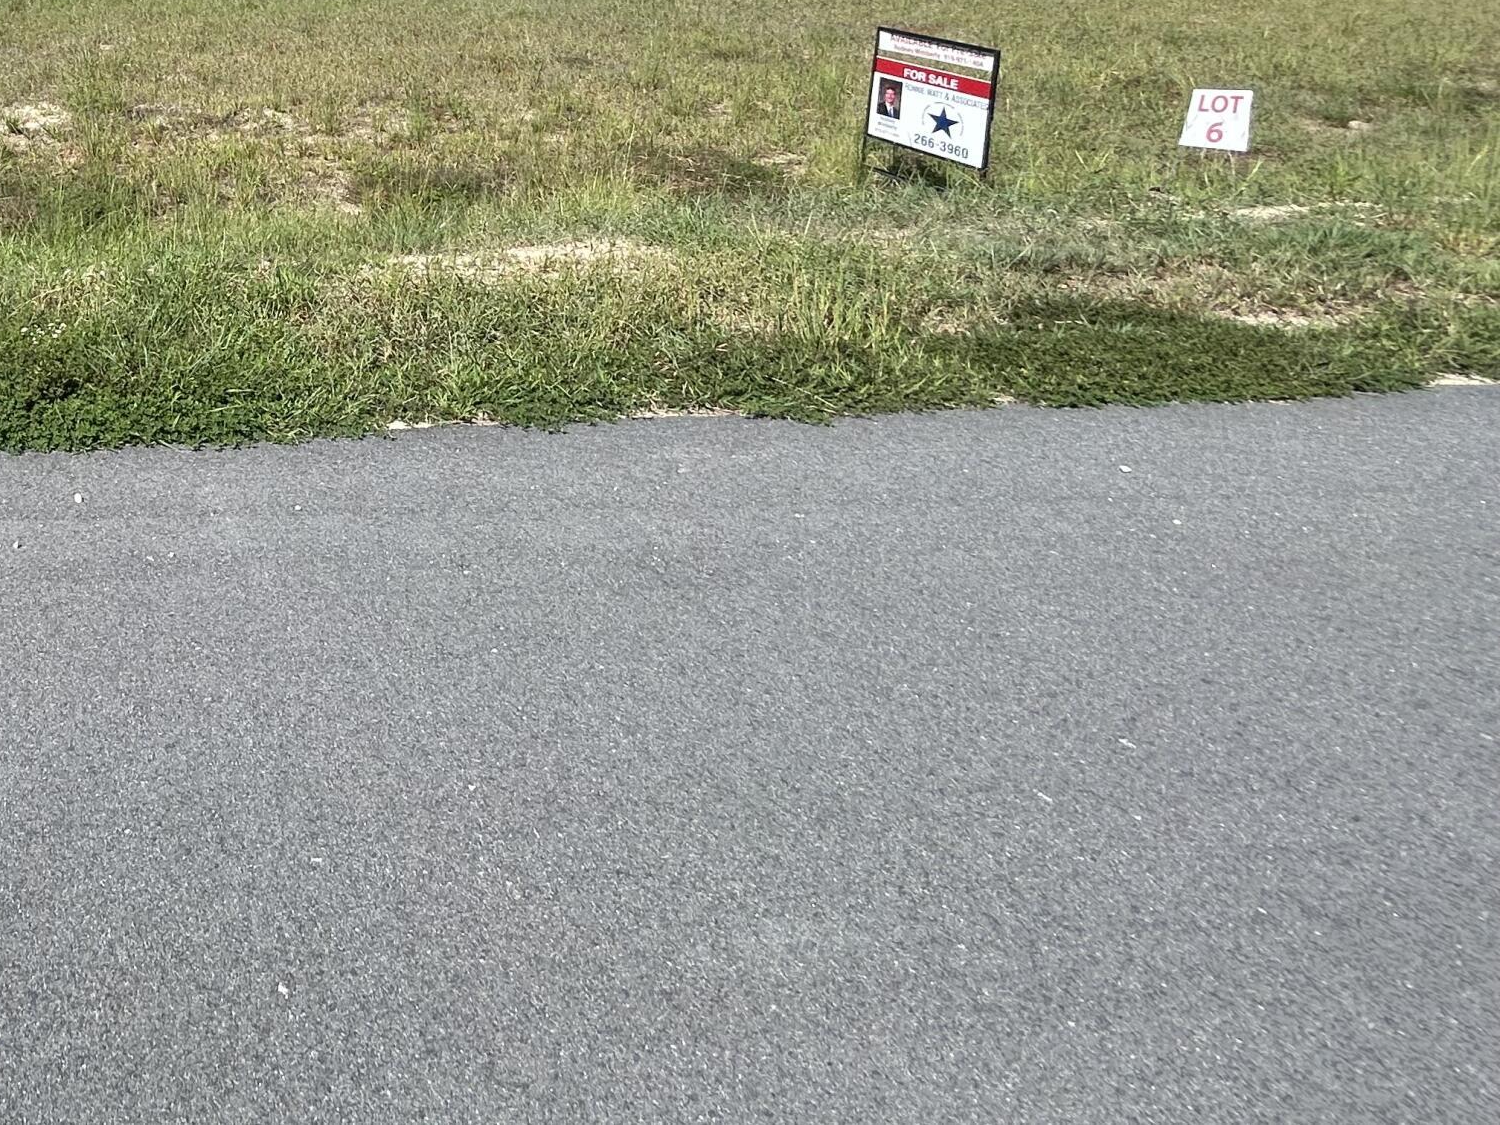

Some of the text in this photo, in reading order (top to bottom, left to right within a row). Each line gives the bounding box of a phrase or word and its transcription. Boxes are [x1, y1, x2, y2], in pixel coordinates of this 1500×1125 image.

[903, 68, 959, 90] FOR SALE
[945, 92, 950, 101] &
[1198, 95, 1244, 114] LOT
[1206, 121, 1223, 143] 6
[914, 133, 969, 159] 266-3960
